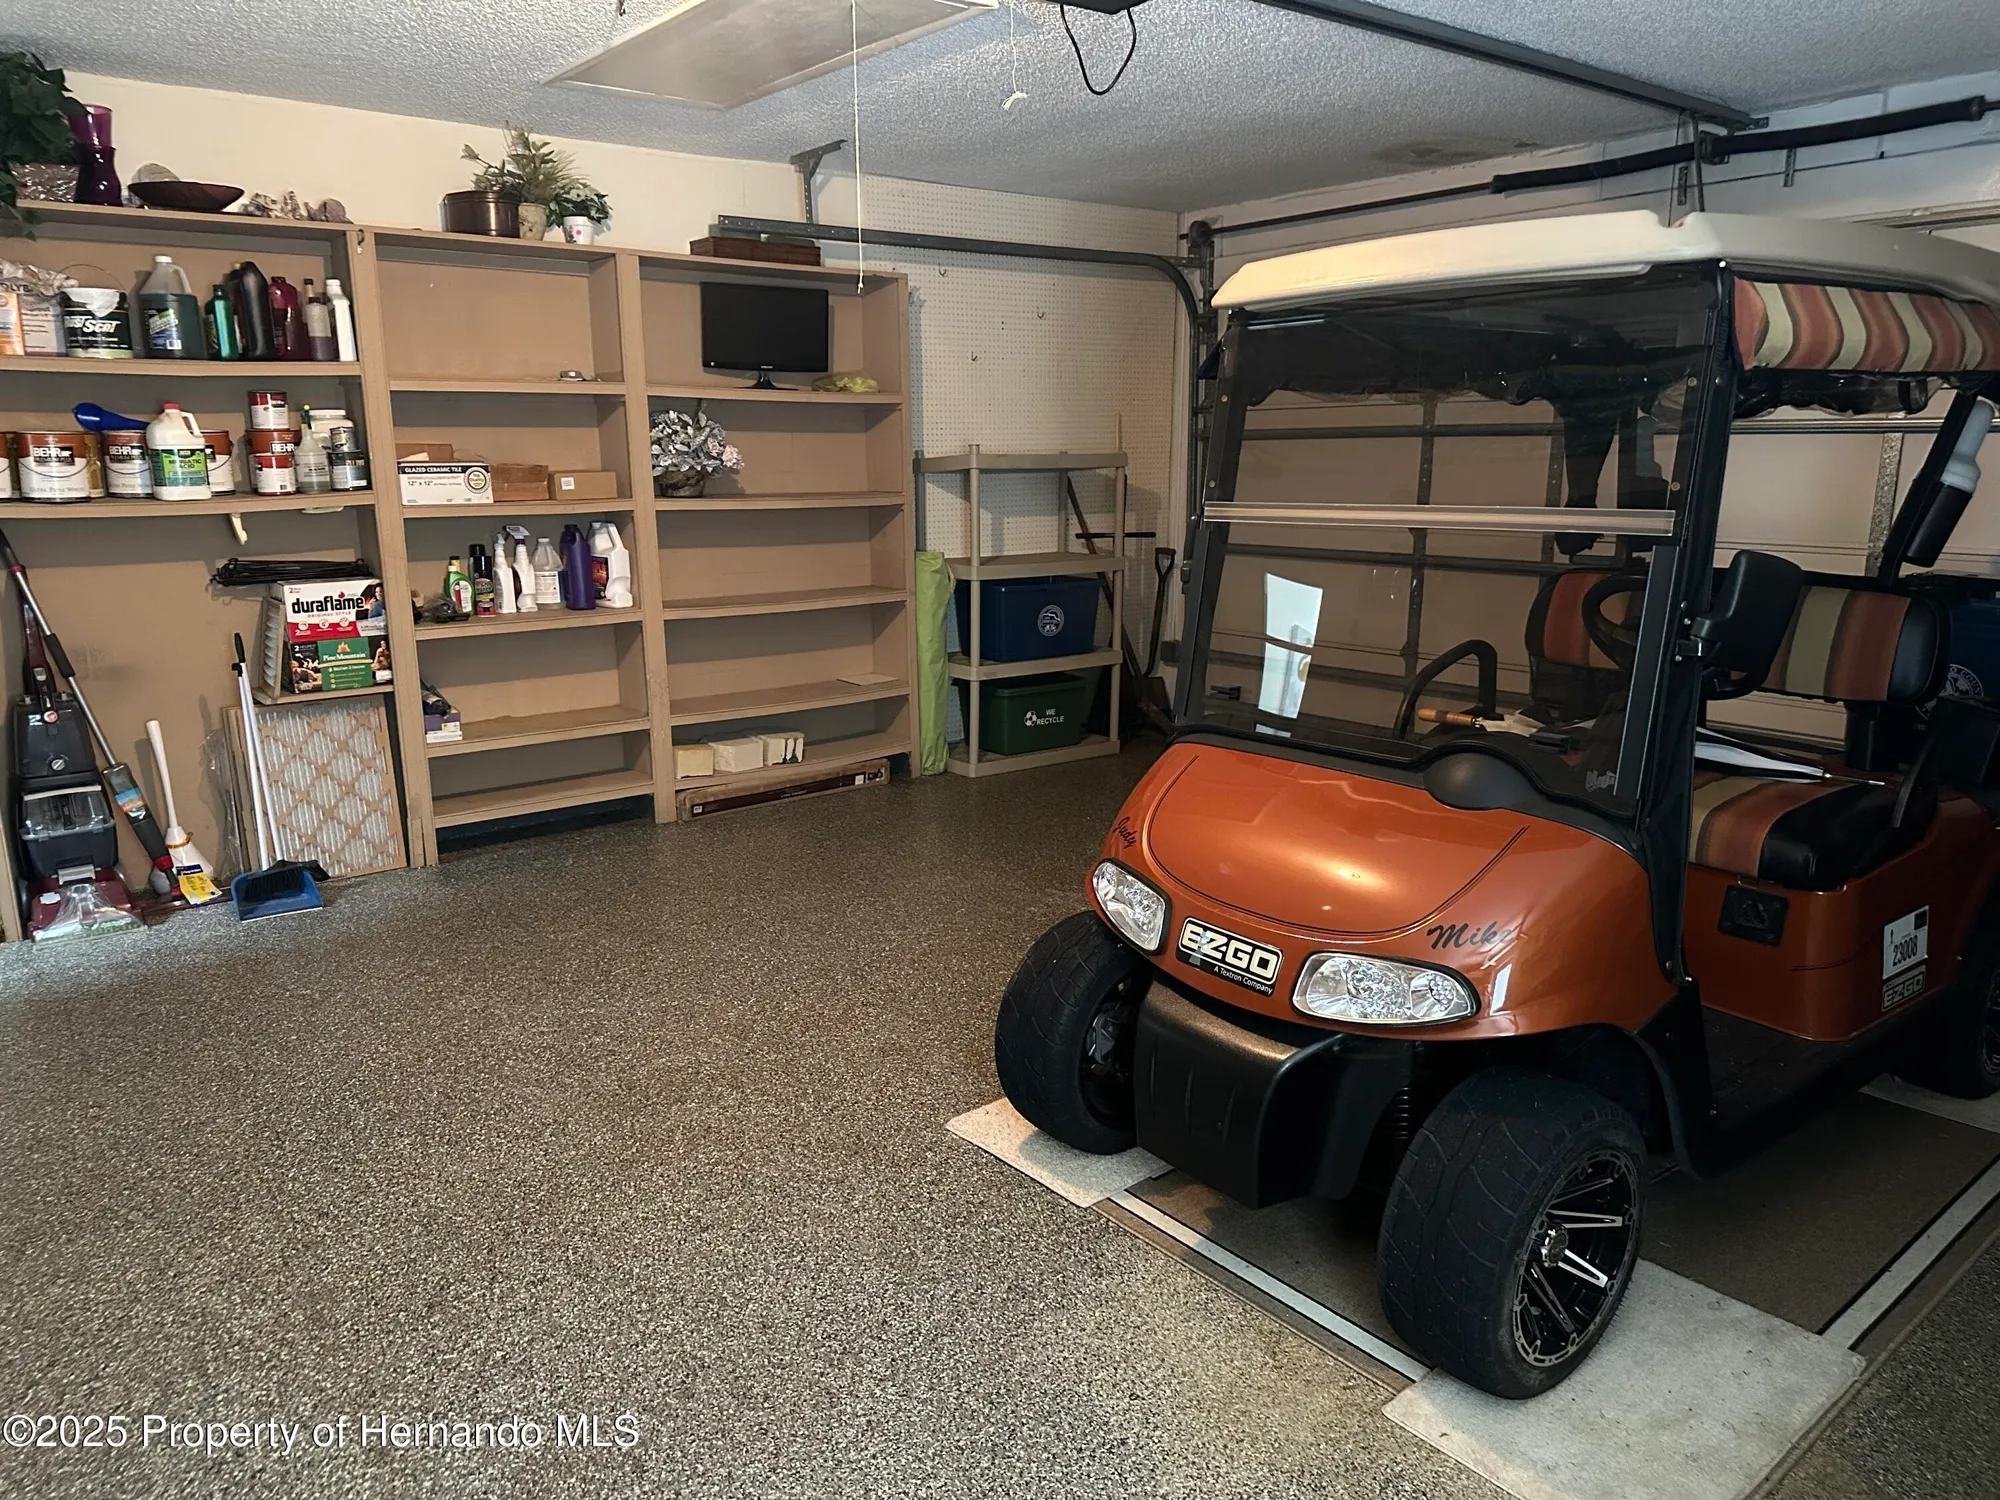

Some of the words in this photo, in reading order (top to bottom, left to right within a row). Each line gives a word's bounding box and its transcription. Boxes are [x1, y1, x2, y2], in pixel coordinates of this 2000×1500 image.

[32, 447, 61, 457] BEHR
[109, 445, 132, 455] BEHR
[271, 443, 295, 452] BEHR
[291, 595, 364, 614] duraflame
[1045, 708, 1056, 716] WE
[1036, 716, 1064, 725] RECYCLE
[1892, 934, 1918, 967] 23008
[1213, 965, 1219, 973] A
[1220, 967, 1242, 982] Textron
[1242, 977, 1274, 995] Company
